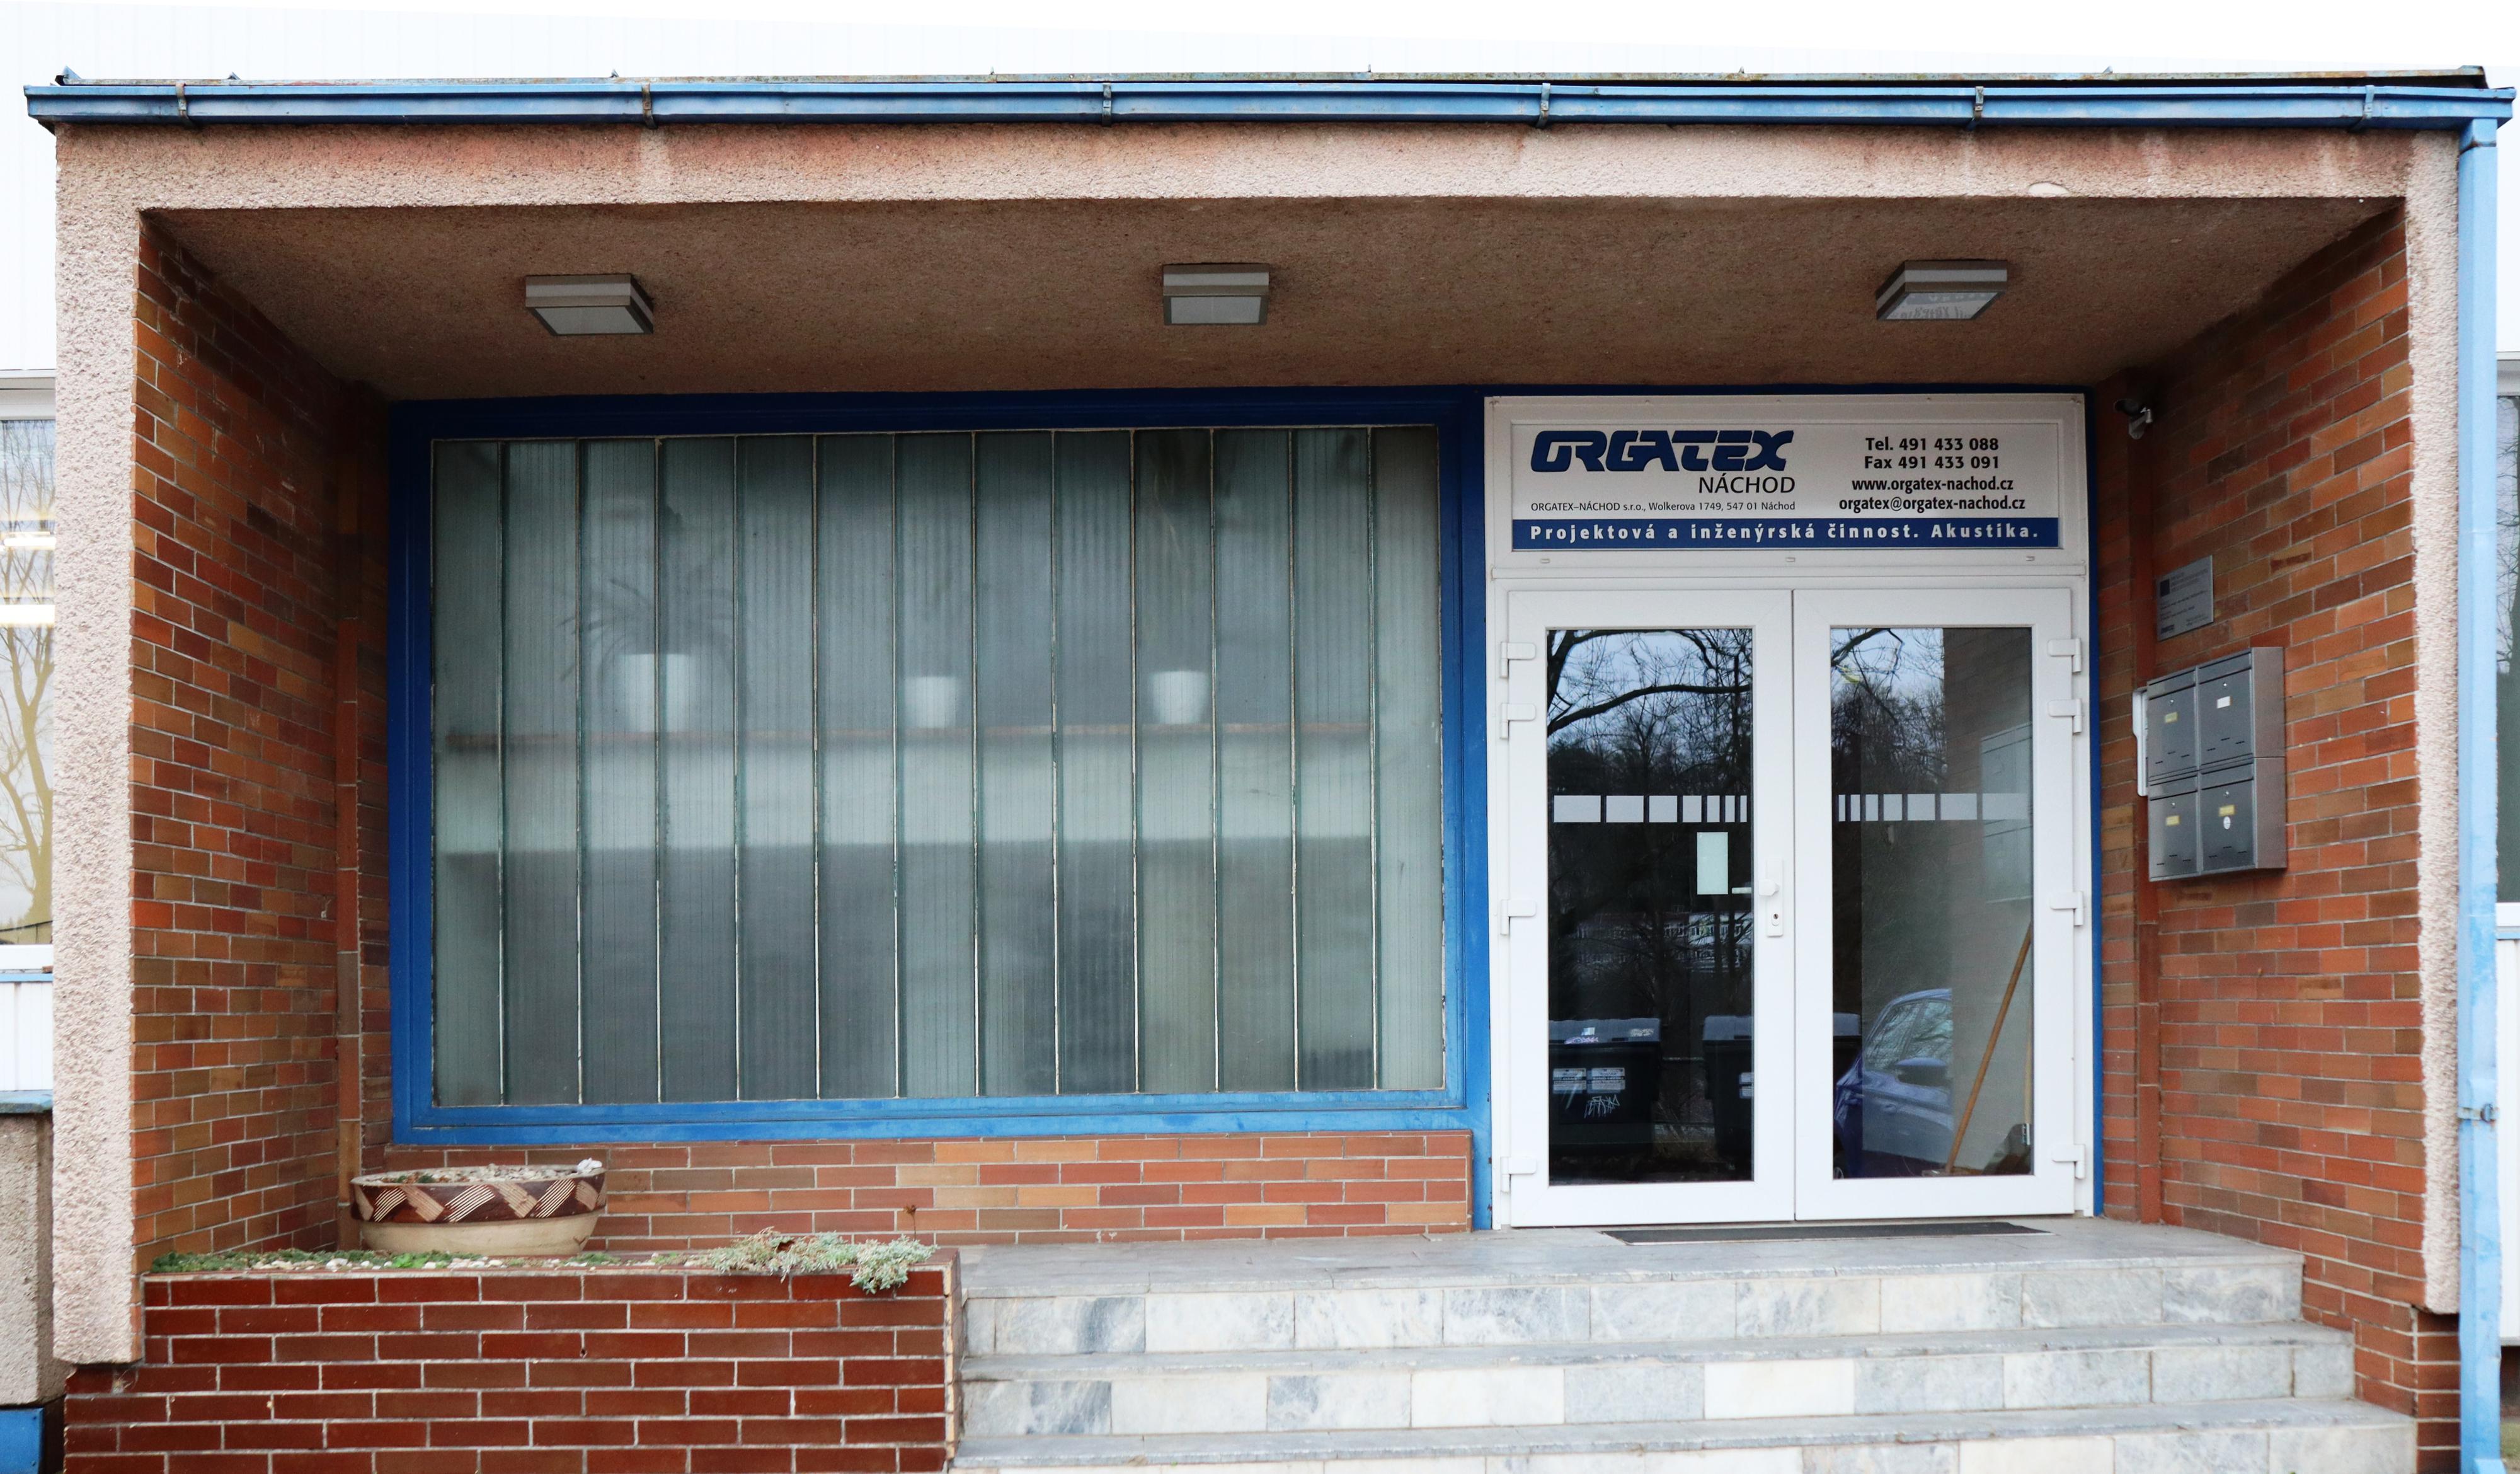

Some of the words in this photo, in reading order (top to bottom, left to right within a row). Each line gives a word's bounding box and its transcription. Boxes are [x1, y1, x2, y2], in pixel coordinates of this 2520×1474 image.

[1865, 437, 1894, 451] Tel.
[1898, 437, 1927, 451] 491
[1934, 437, 1963, 451] 433
[1969, 437, 1998, 451] 088
[1864, 456, 1893, 469] Fax
[1898, 456, 1927, 469] 491
[1934, 456, 1964, 469] 433
[1971, 456, 1998, 469] 091
[1698, 473, 1796, 493] NÁCHOD
[1852, 476, 2014, 494] www.orgatex-nachod.cz
[1649, 502, 1695, 511] Wolkerova
[1699, 502, 1724, 512] 1749,
[1726, 502, 1744, 511] 547
[1746, 502, 1758, 510] 01
[1761, 502, 1796, 510] Náchod
[1839, 495, 2025, 513] orgatex@orgatex-nachod.cz
[1530, 524, 1655, 543] Projektová
[1668, 529, 1678, 539] a
[1691, 523, 1814, 542] inženýrská
[1827, 523, 1919, 538] činnost.
[1931, 522, 2038, 538] Akustika.
